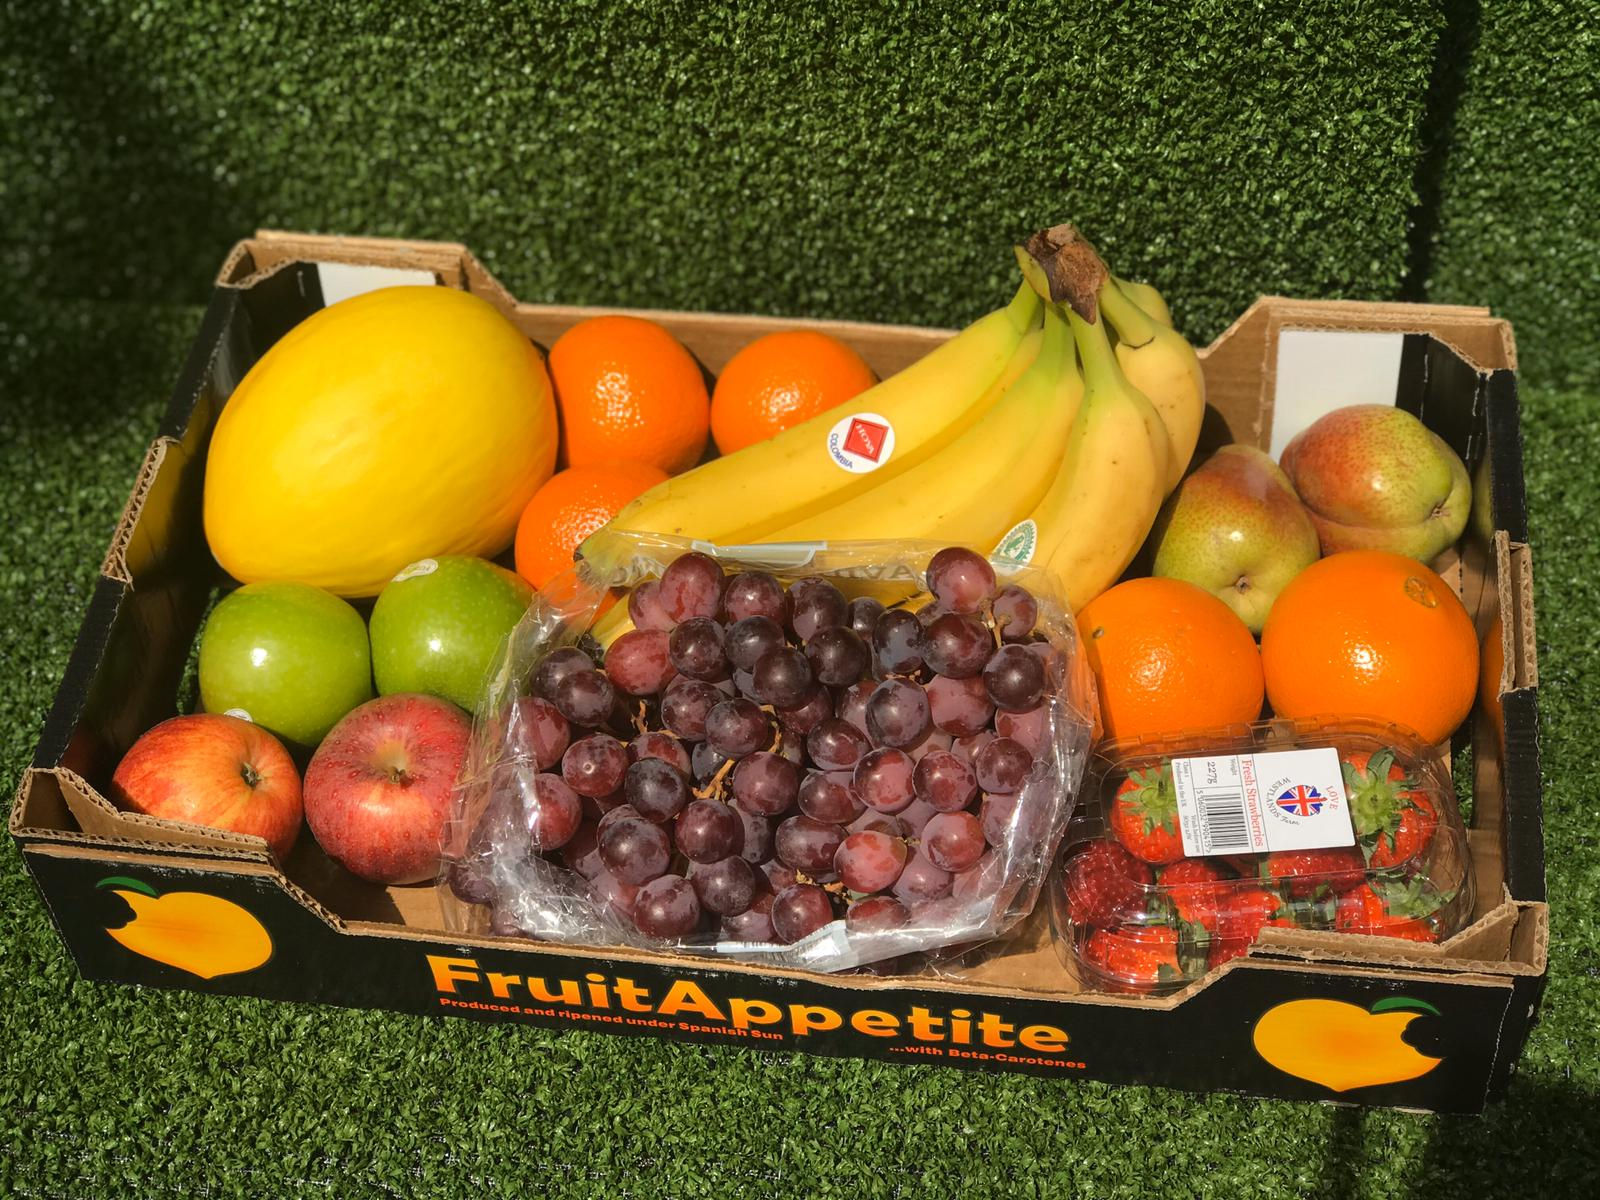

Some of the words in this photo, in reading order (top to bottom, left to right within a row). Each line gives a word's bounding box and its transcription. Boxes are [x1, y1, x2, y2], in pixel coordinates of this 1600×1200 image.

[830, 433, 853, 469] COLOMBIA
[1207, 761, 1218, 785] 227g
[1242, 760, 1256, 786] Fresh
[1266, 777, 1292, 818] WESTLANDS
[1326, 785, 1339, 810] LOVE
[1246, 788, 1264, 847] Strawberries
[426, 954, 1069, 1052] FruitAppetite
[439, 998, 520, 1013] Produced
[524, 1008, 555, 1017] and
[559, 1010, 624, 1023] ripened
[626, 1017, 676, 1029] under
[679, 1022, 748, 1036] Spanish
[751, 1030, 783, 1040] Sun
[948, 1049, 1086, 1069] Beta-Carotenes
